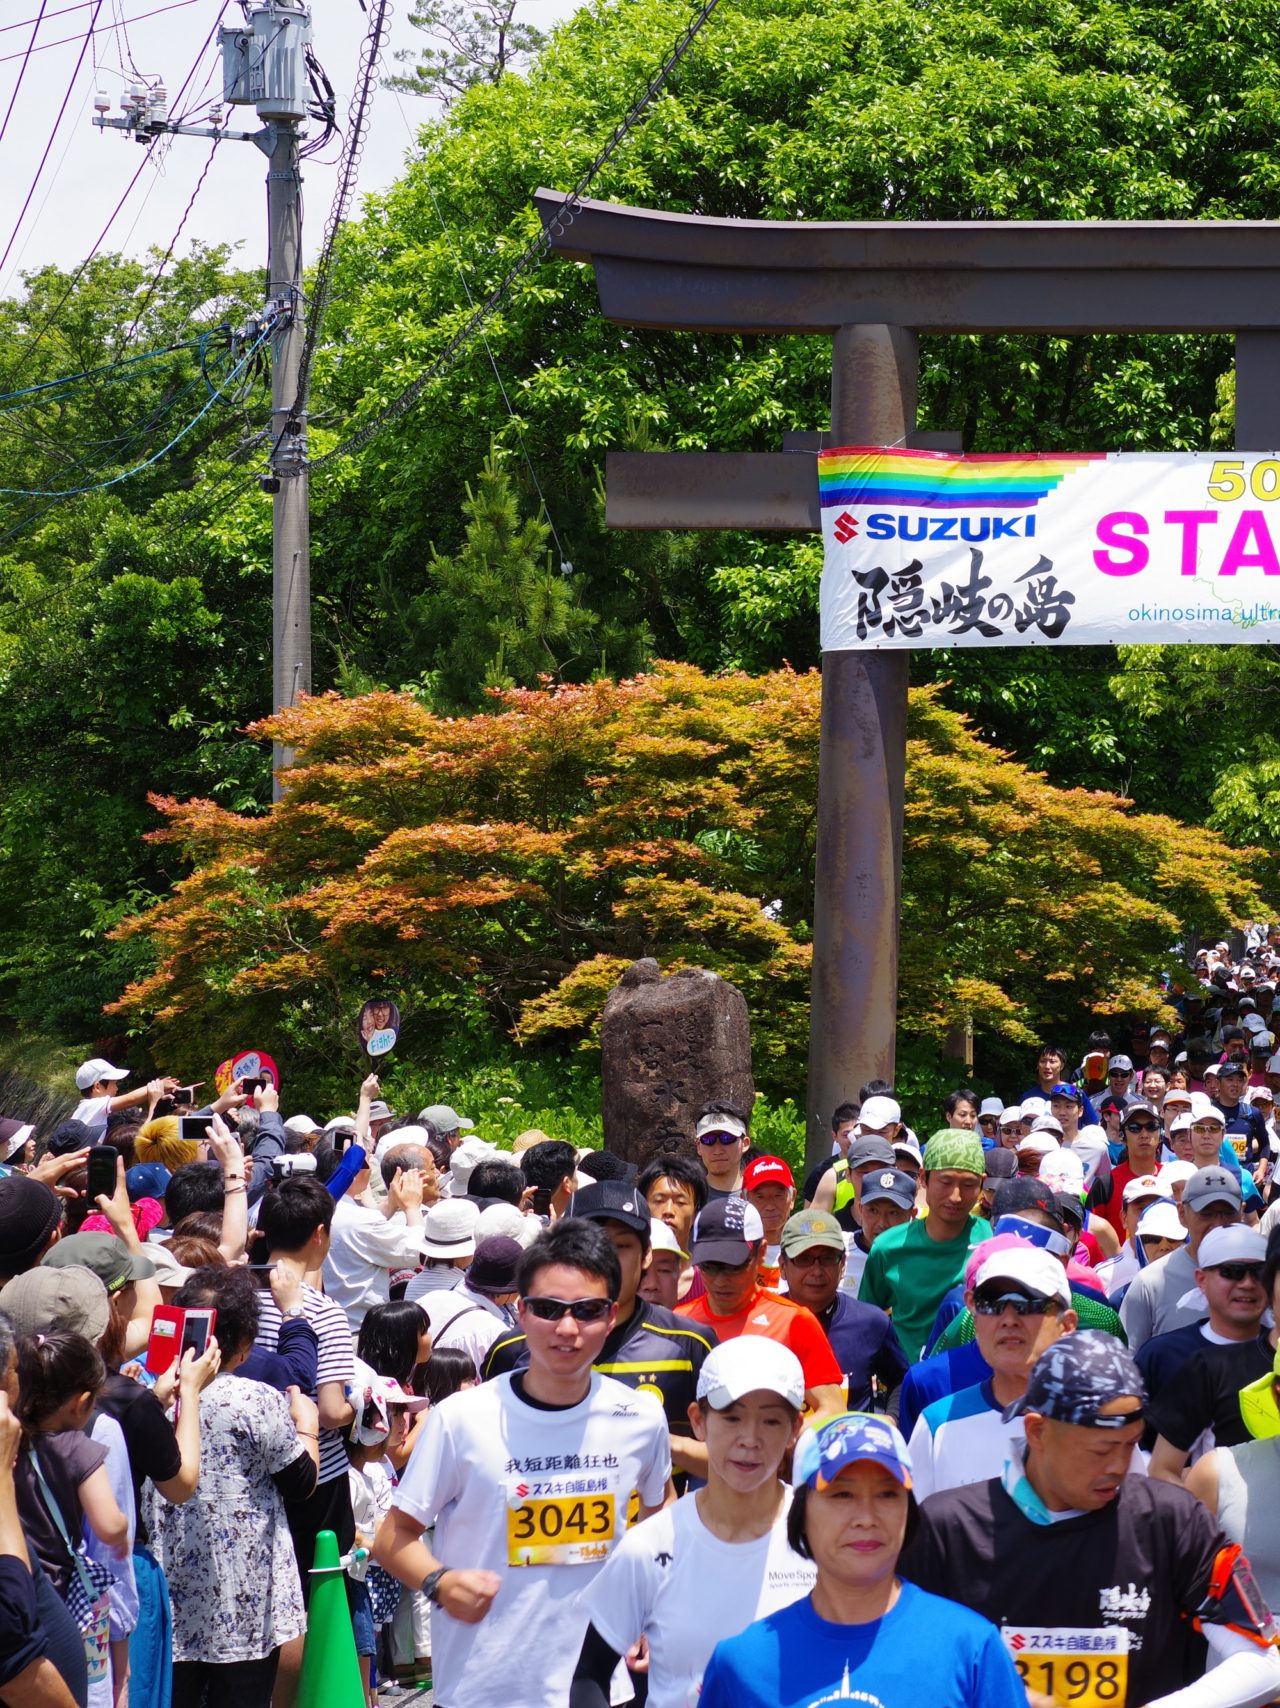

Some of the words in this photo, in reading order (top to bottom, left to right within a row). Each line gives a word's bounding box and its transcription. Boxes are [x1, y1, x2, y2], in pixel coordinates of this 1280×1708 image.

[865, 513, 1036, 542] SUZUKI
[851, 547, 1076, 641] 隠岐の島
[1128, 603, 1232, 621] okinosima
[514, 1500, 610, 1539] 3043
